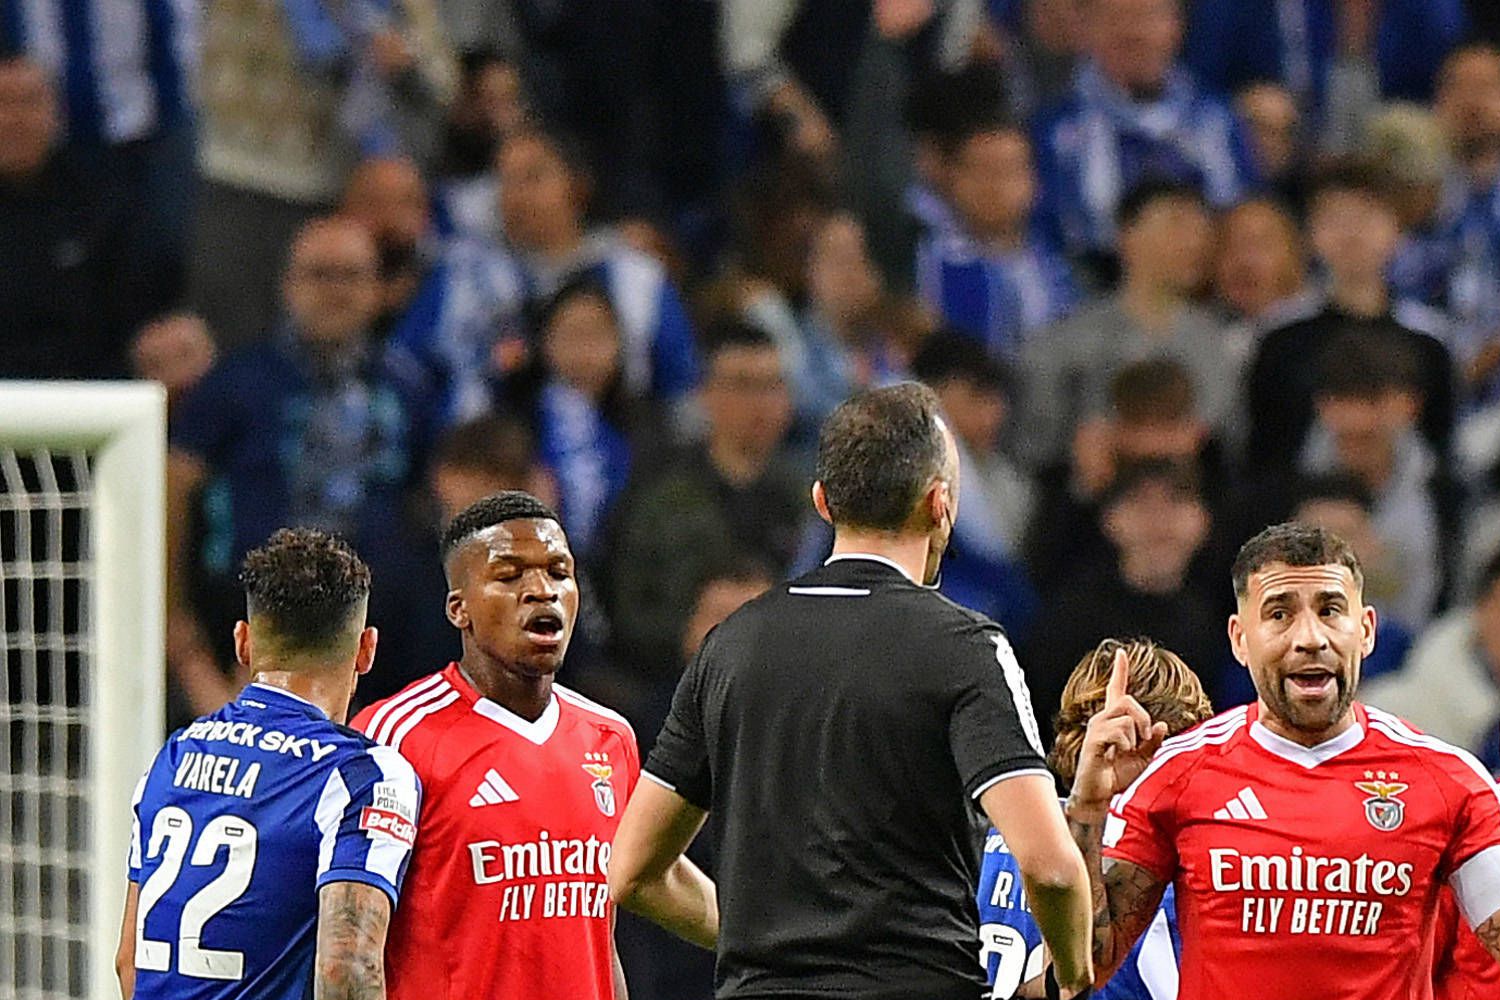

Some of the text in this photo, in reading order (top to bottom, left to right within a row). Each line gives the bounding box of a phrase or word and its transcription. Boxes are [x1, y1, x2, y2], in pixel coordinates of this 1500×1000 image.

[259, 731, 337, 762] SKY
[174, 752, 261, 798] VARELA
[467, 830, 612, 885] Emirate
[1209, 845, 1413, 896] Emirates
[135, 806, 259, 980] 22
[499, 881, 609, 922] FLY BETTER
[1242, 897, 1383, 935] FLY BETTER
